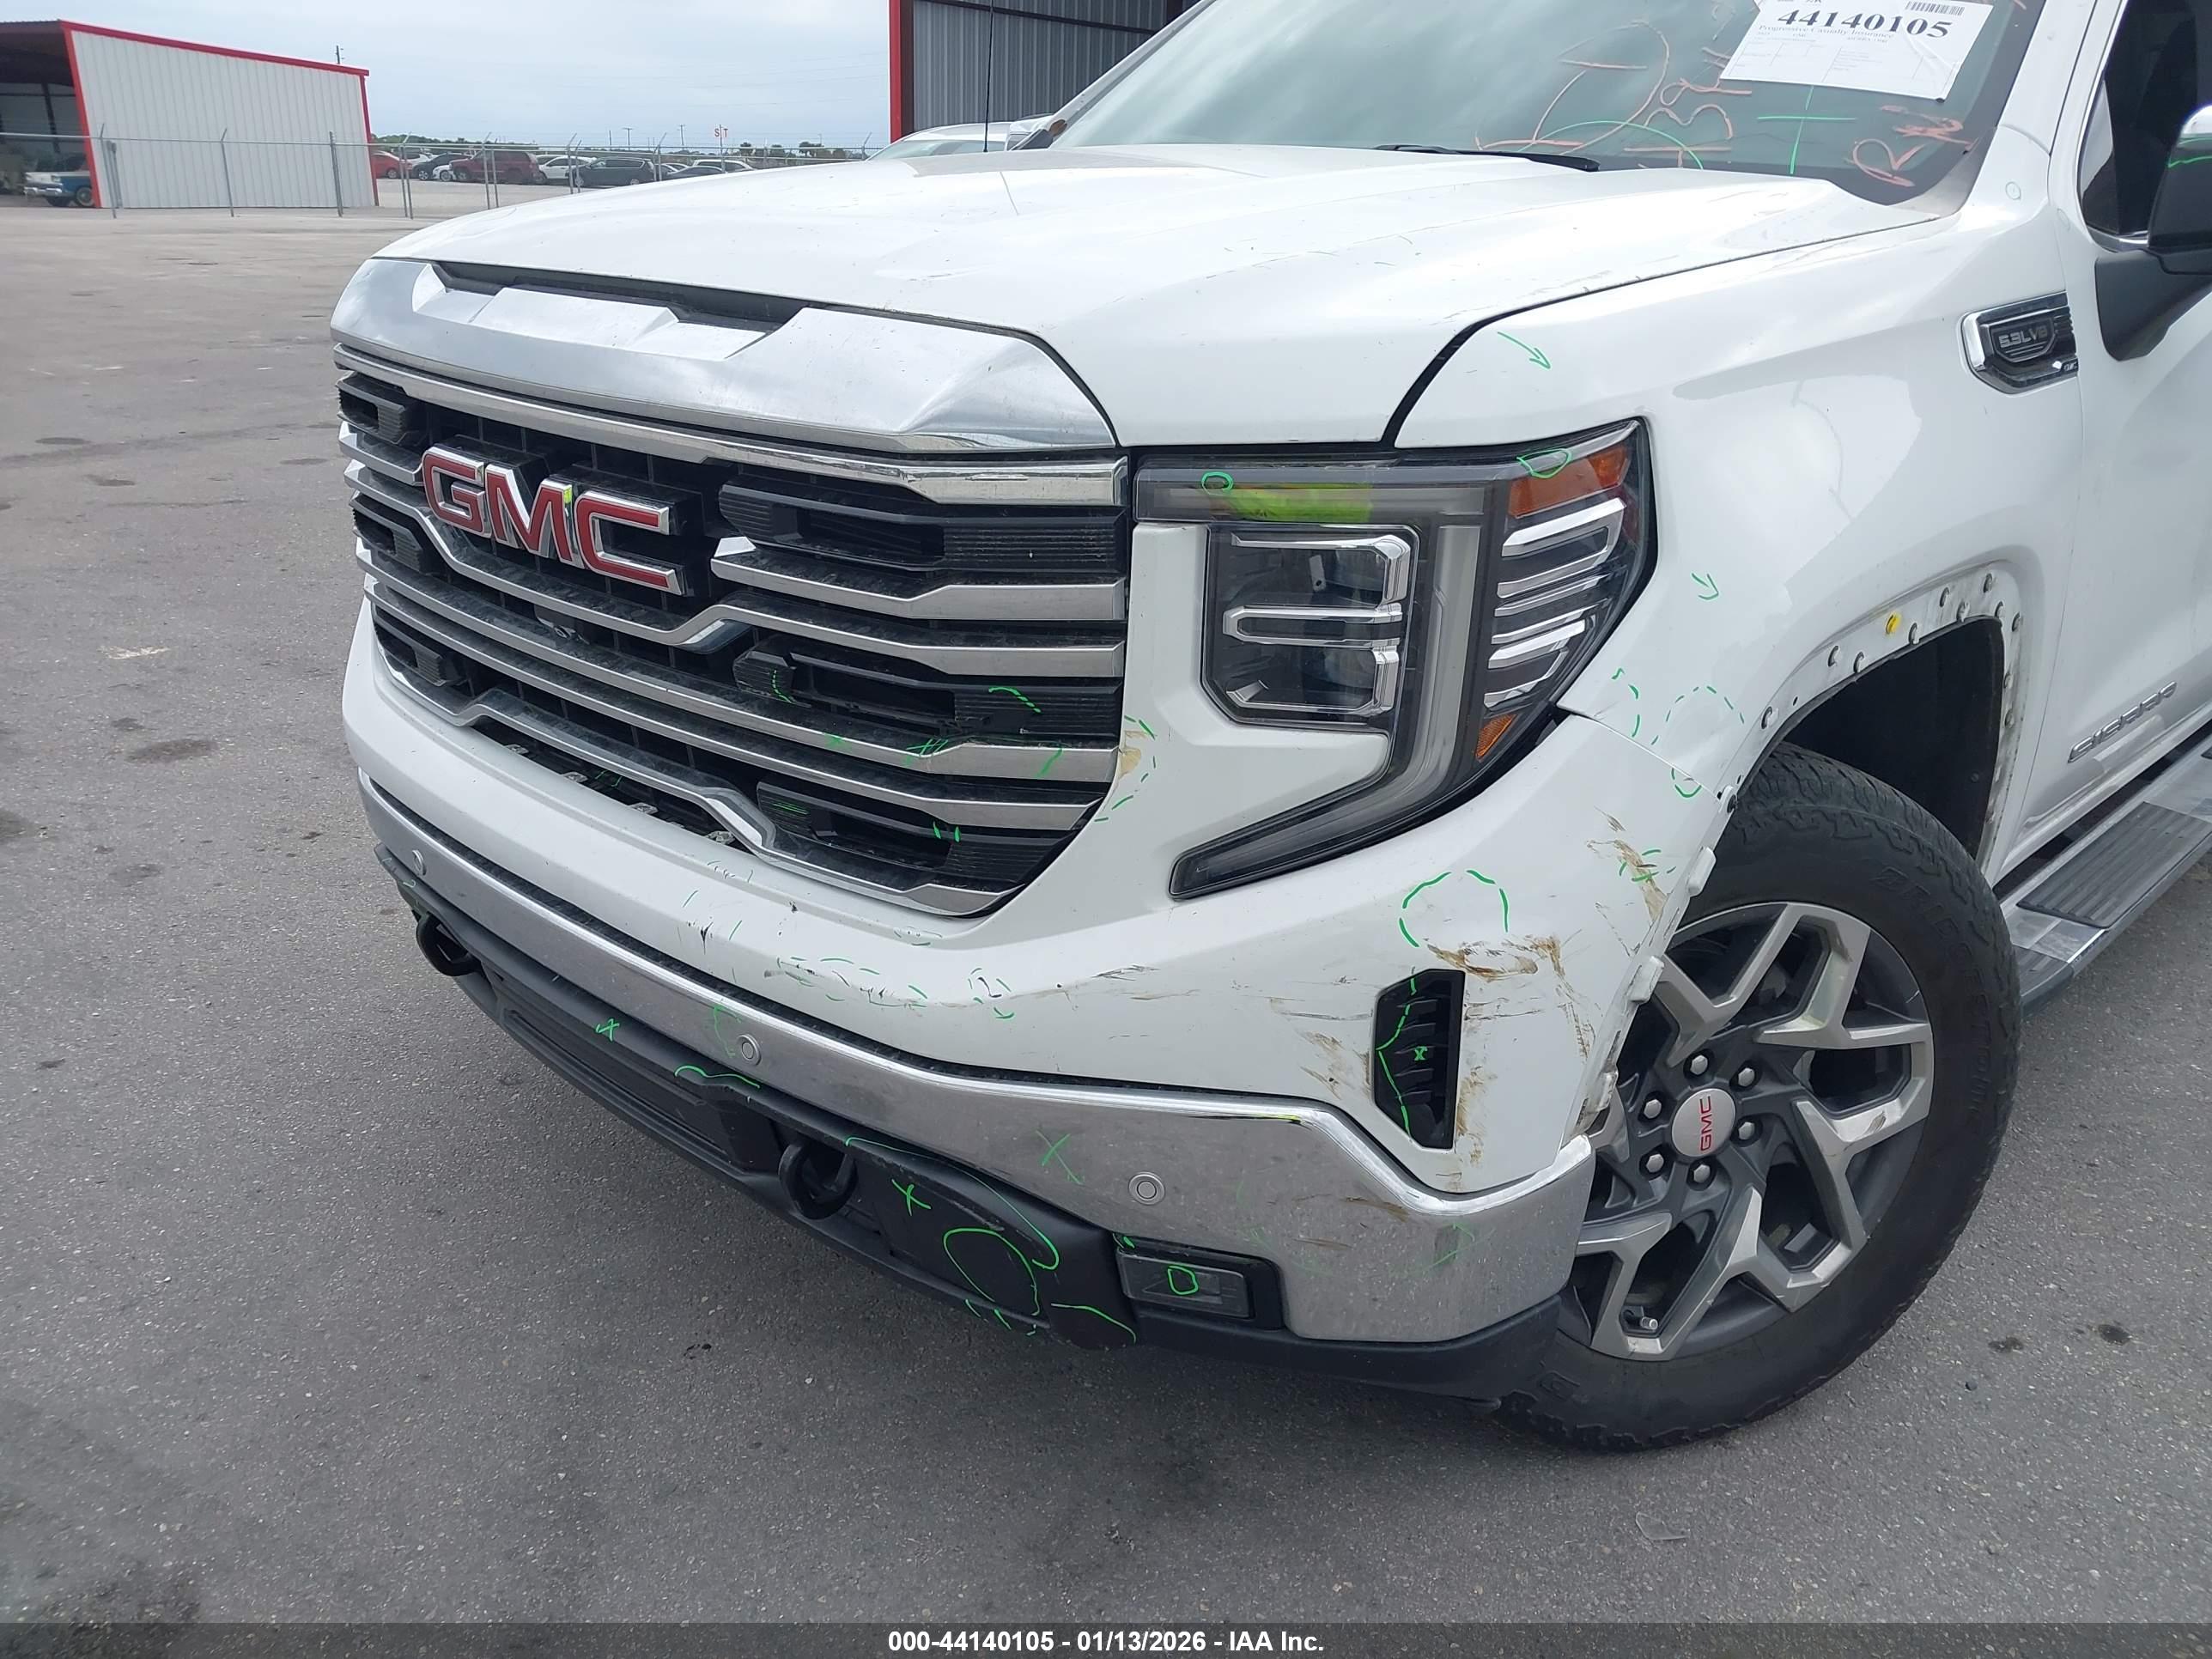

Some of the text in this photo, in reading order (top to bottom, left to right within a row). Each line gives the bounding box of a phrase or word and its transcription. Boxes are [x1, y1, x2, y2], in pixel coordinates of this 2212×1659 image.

[1778, 9, 1953, 38] 44140105
[422, 446, 685, 597] GMC
[1698, 1093, 1713, 1152] GMC
